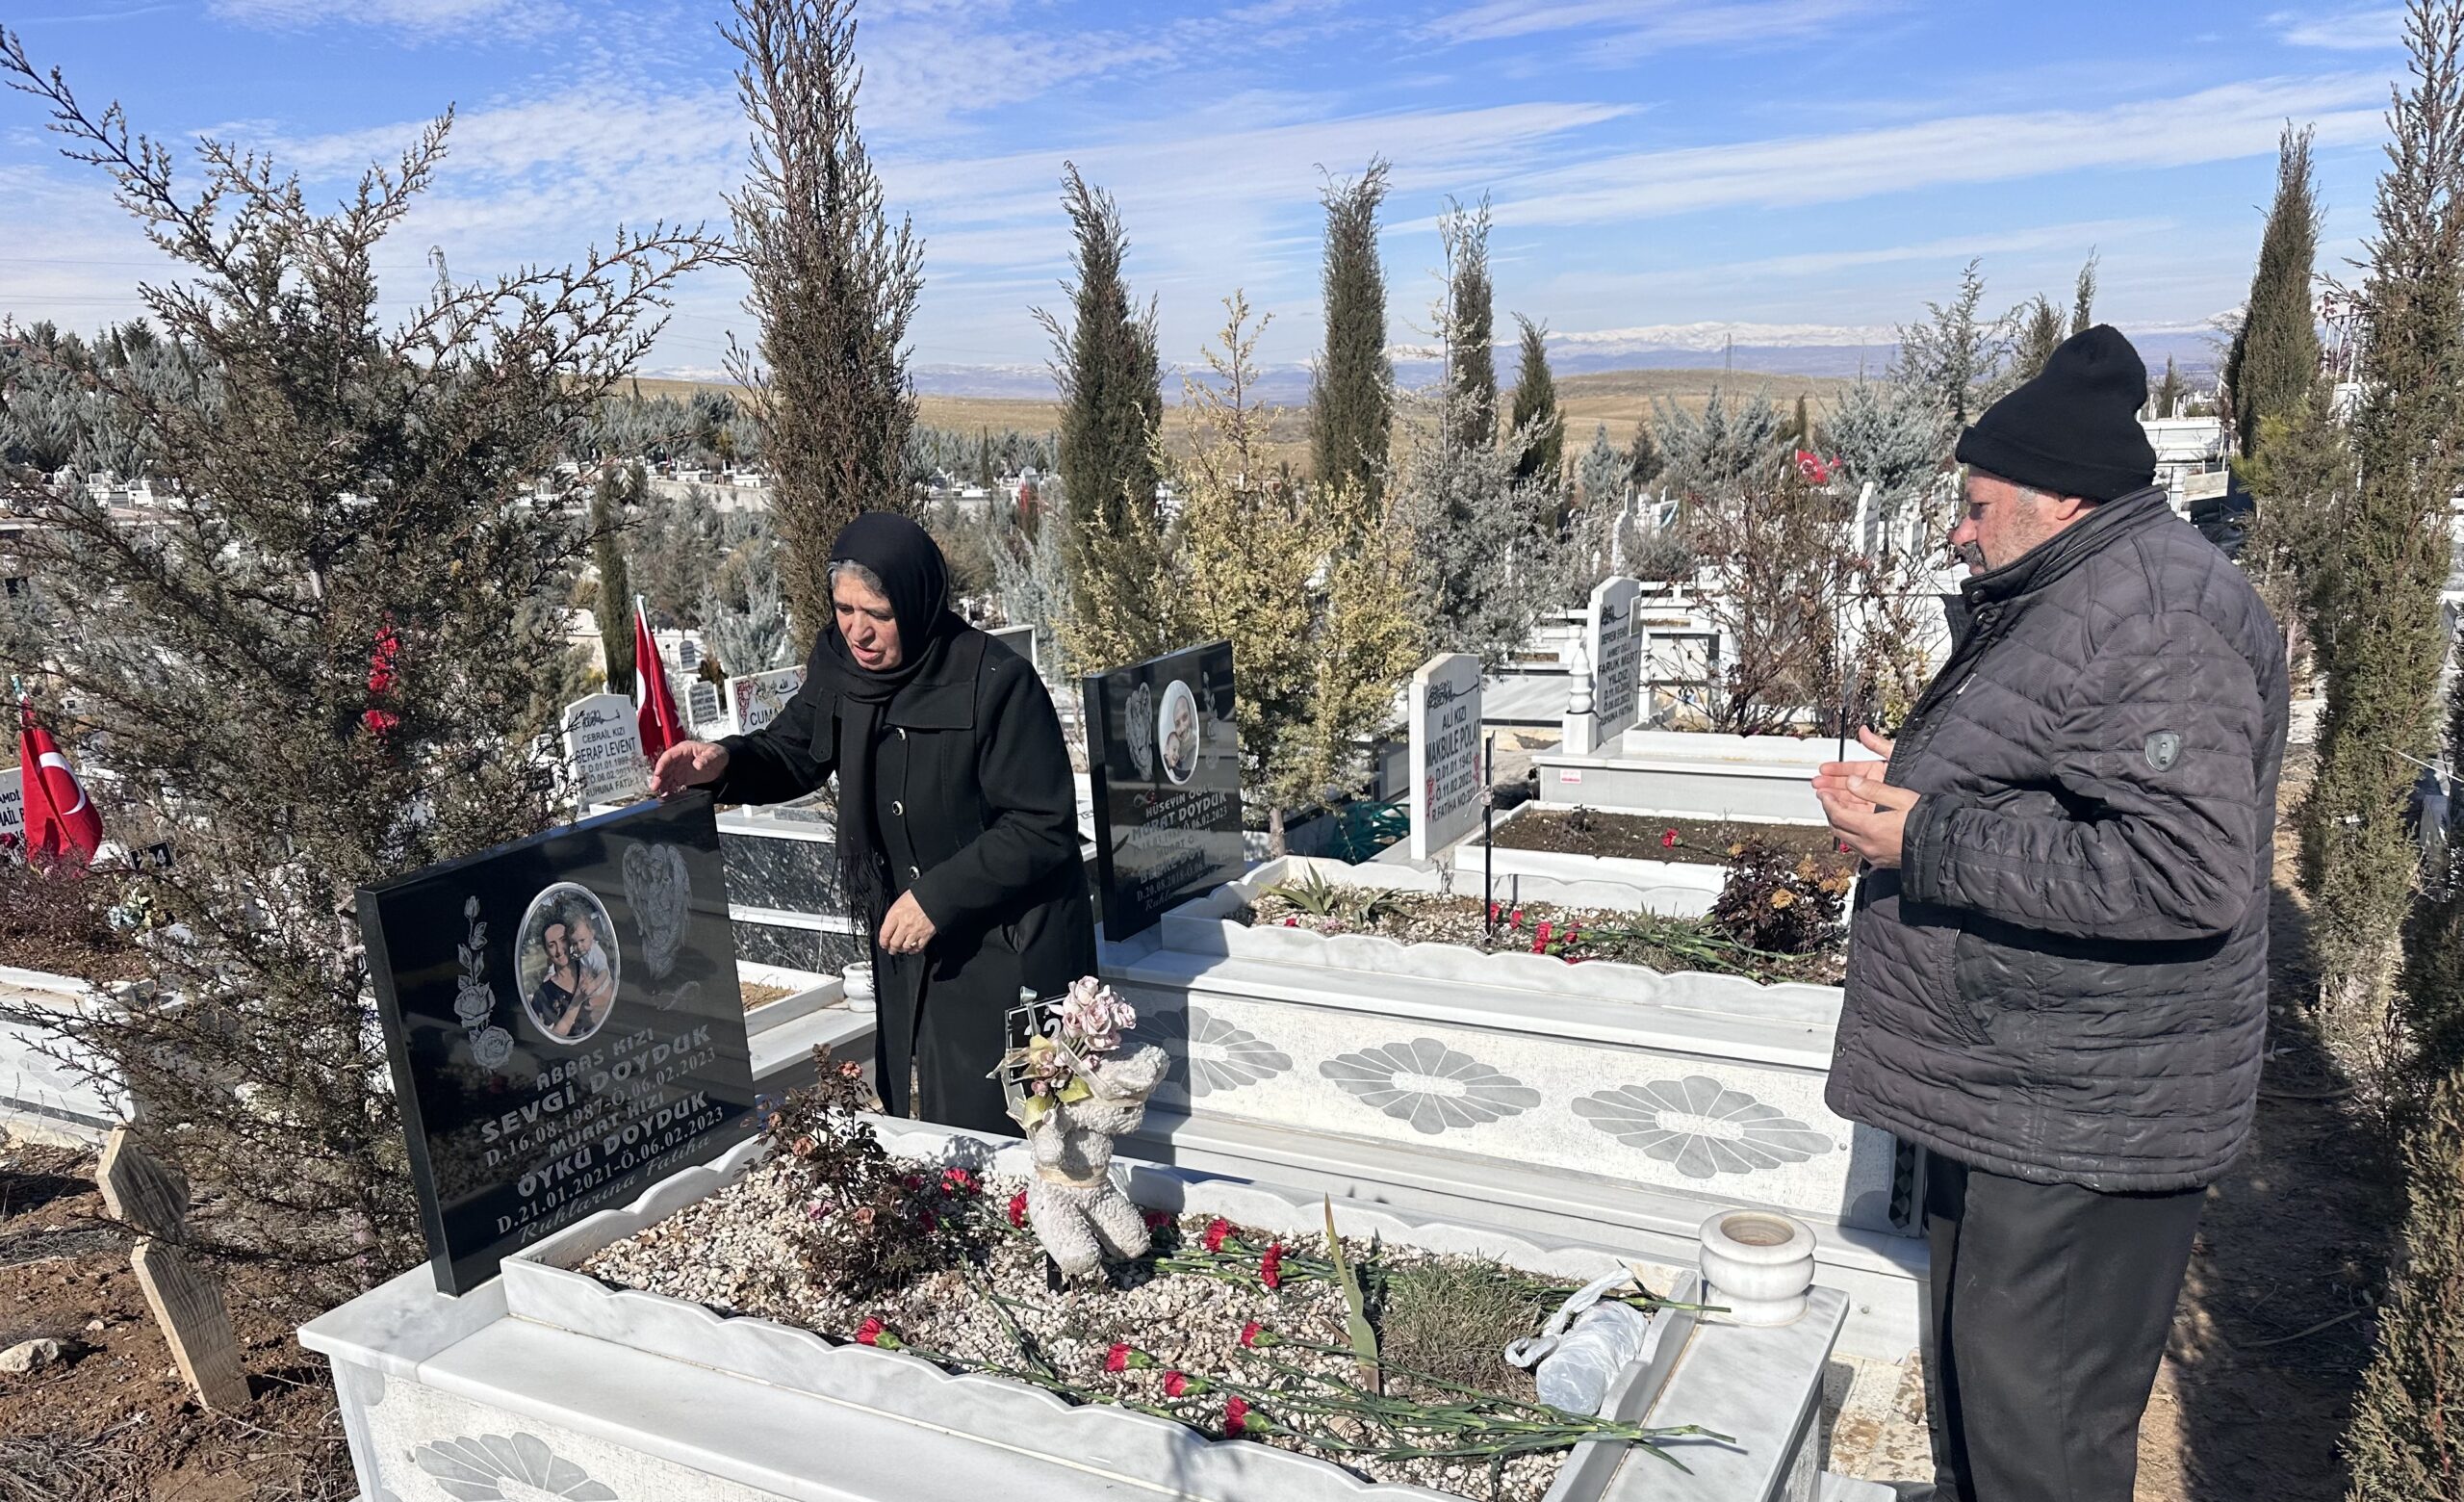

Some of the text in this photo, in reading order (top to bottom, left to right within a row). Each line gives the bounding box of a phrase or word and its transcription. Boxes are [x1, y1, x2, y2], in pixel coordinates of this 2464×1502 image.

[1598, 650, 1638, 678] FARUK MERT
[581, 726, 626, 744] CEBRAİL KIZI
[1425, 717, 1481, 768] MAKBULE POLAT
[1442, 705, 1467, 732] ALİ KIZI
[604, 737, 635, 757] LEVENT
[1435, 751, 1473, 783] D.01.01.1943
[1145, 792, 1186, 818] HÜSEYİN
[1435, 769, 1473, 802] Ö.11.02.2023
[1132, 811, 1176, 842] MURAT
[1178, 790, 1227, 822] DOYDUK
[480, 1023, 712, 1144] SEVGİ DOYDUK
[536, 1026, 655, 1092] ABBAS KIZI
[484, 1047, 716, 1168] D.16.08.1987-Ö.06.02.2023
[549, 1090, 664, 1157] MURAT KIZI
[517, 1089, 708, 1198] ÖYKÜ DOYDUK
[496, 1105, 724, 1235] D.21.01.2021-Ö.06.02.2023
